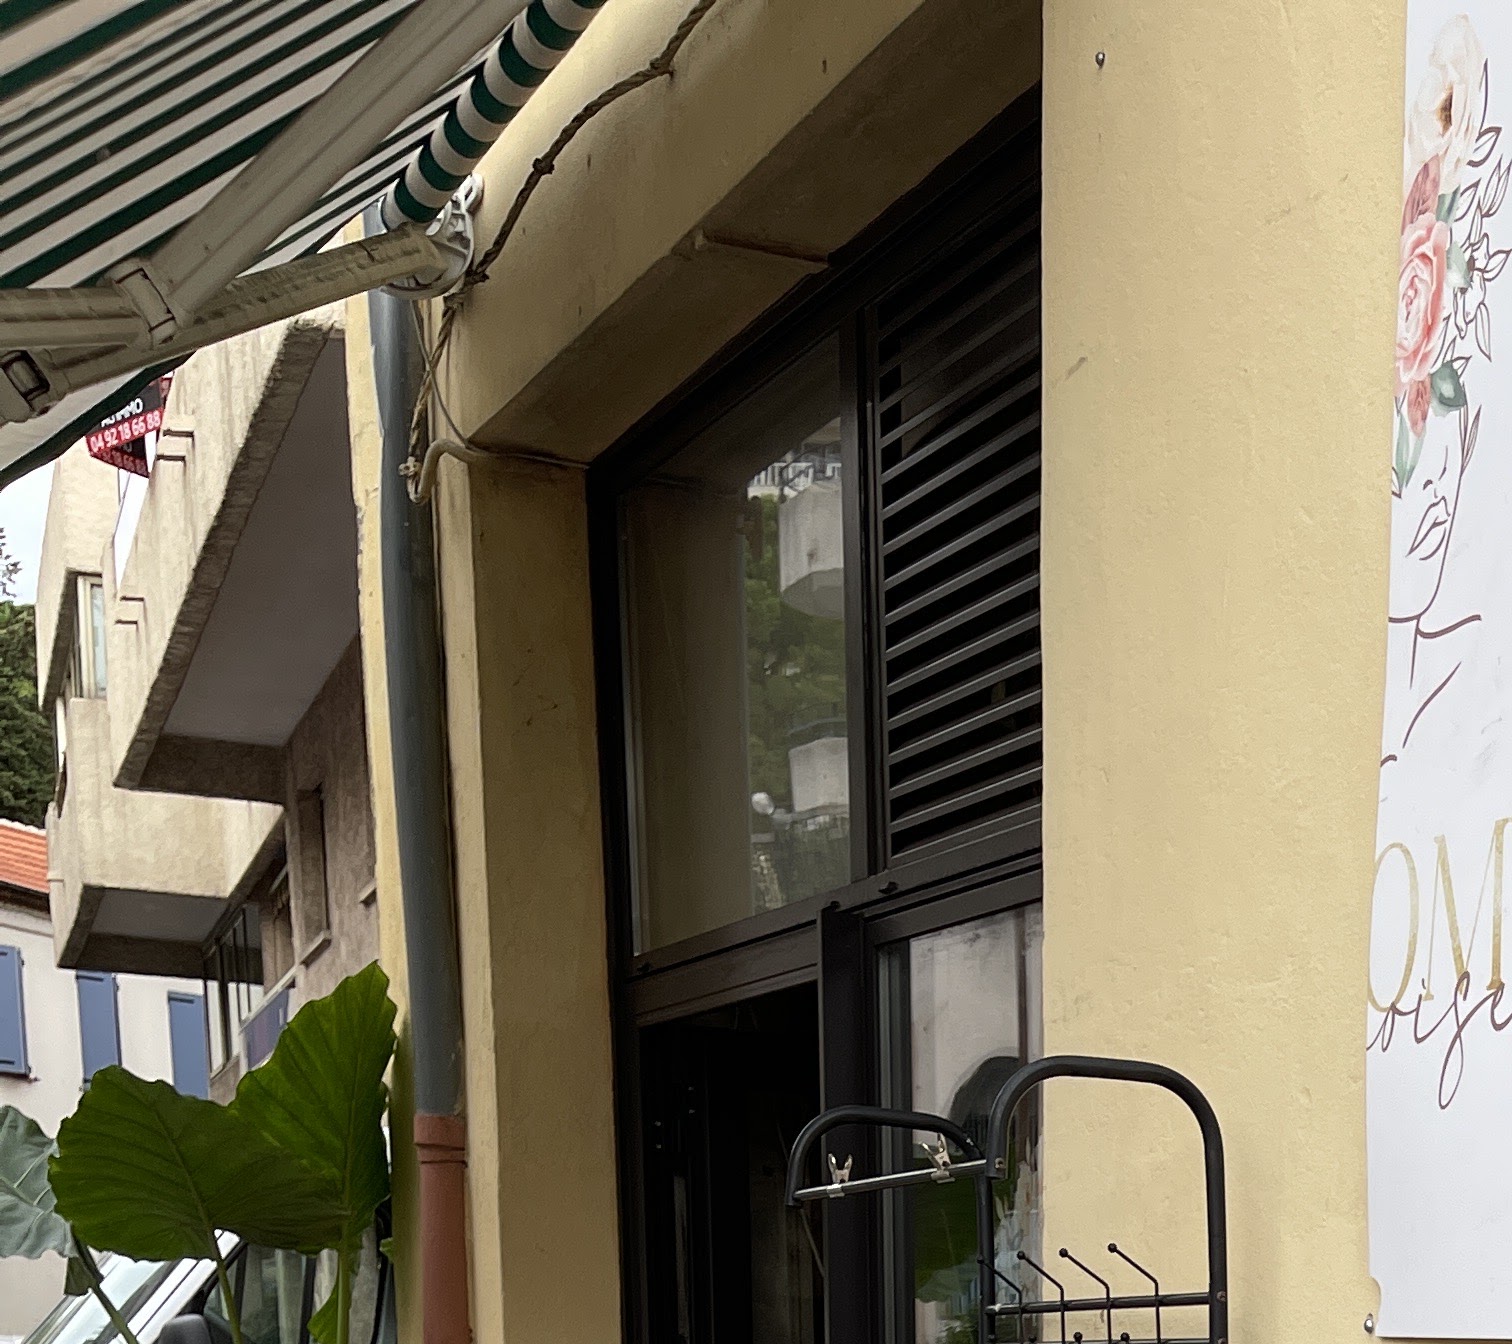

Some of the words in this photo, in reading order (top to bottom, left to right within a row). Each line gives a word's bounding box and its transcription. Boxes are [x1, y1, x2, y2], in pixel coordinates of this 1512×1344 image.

[89, 433, 104, 452] 04
[103, 428, 117, 447] 92
[118, 421, 131, 440] 18
[131, 416, 146, 435] 66
[146, 410, 160, 429] 88
